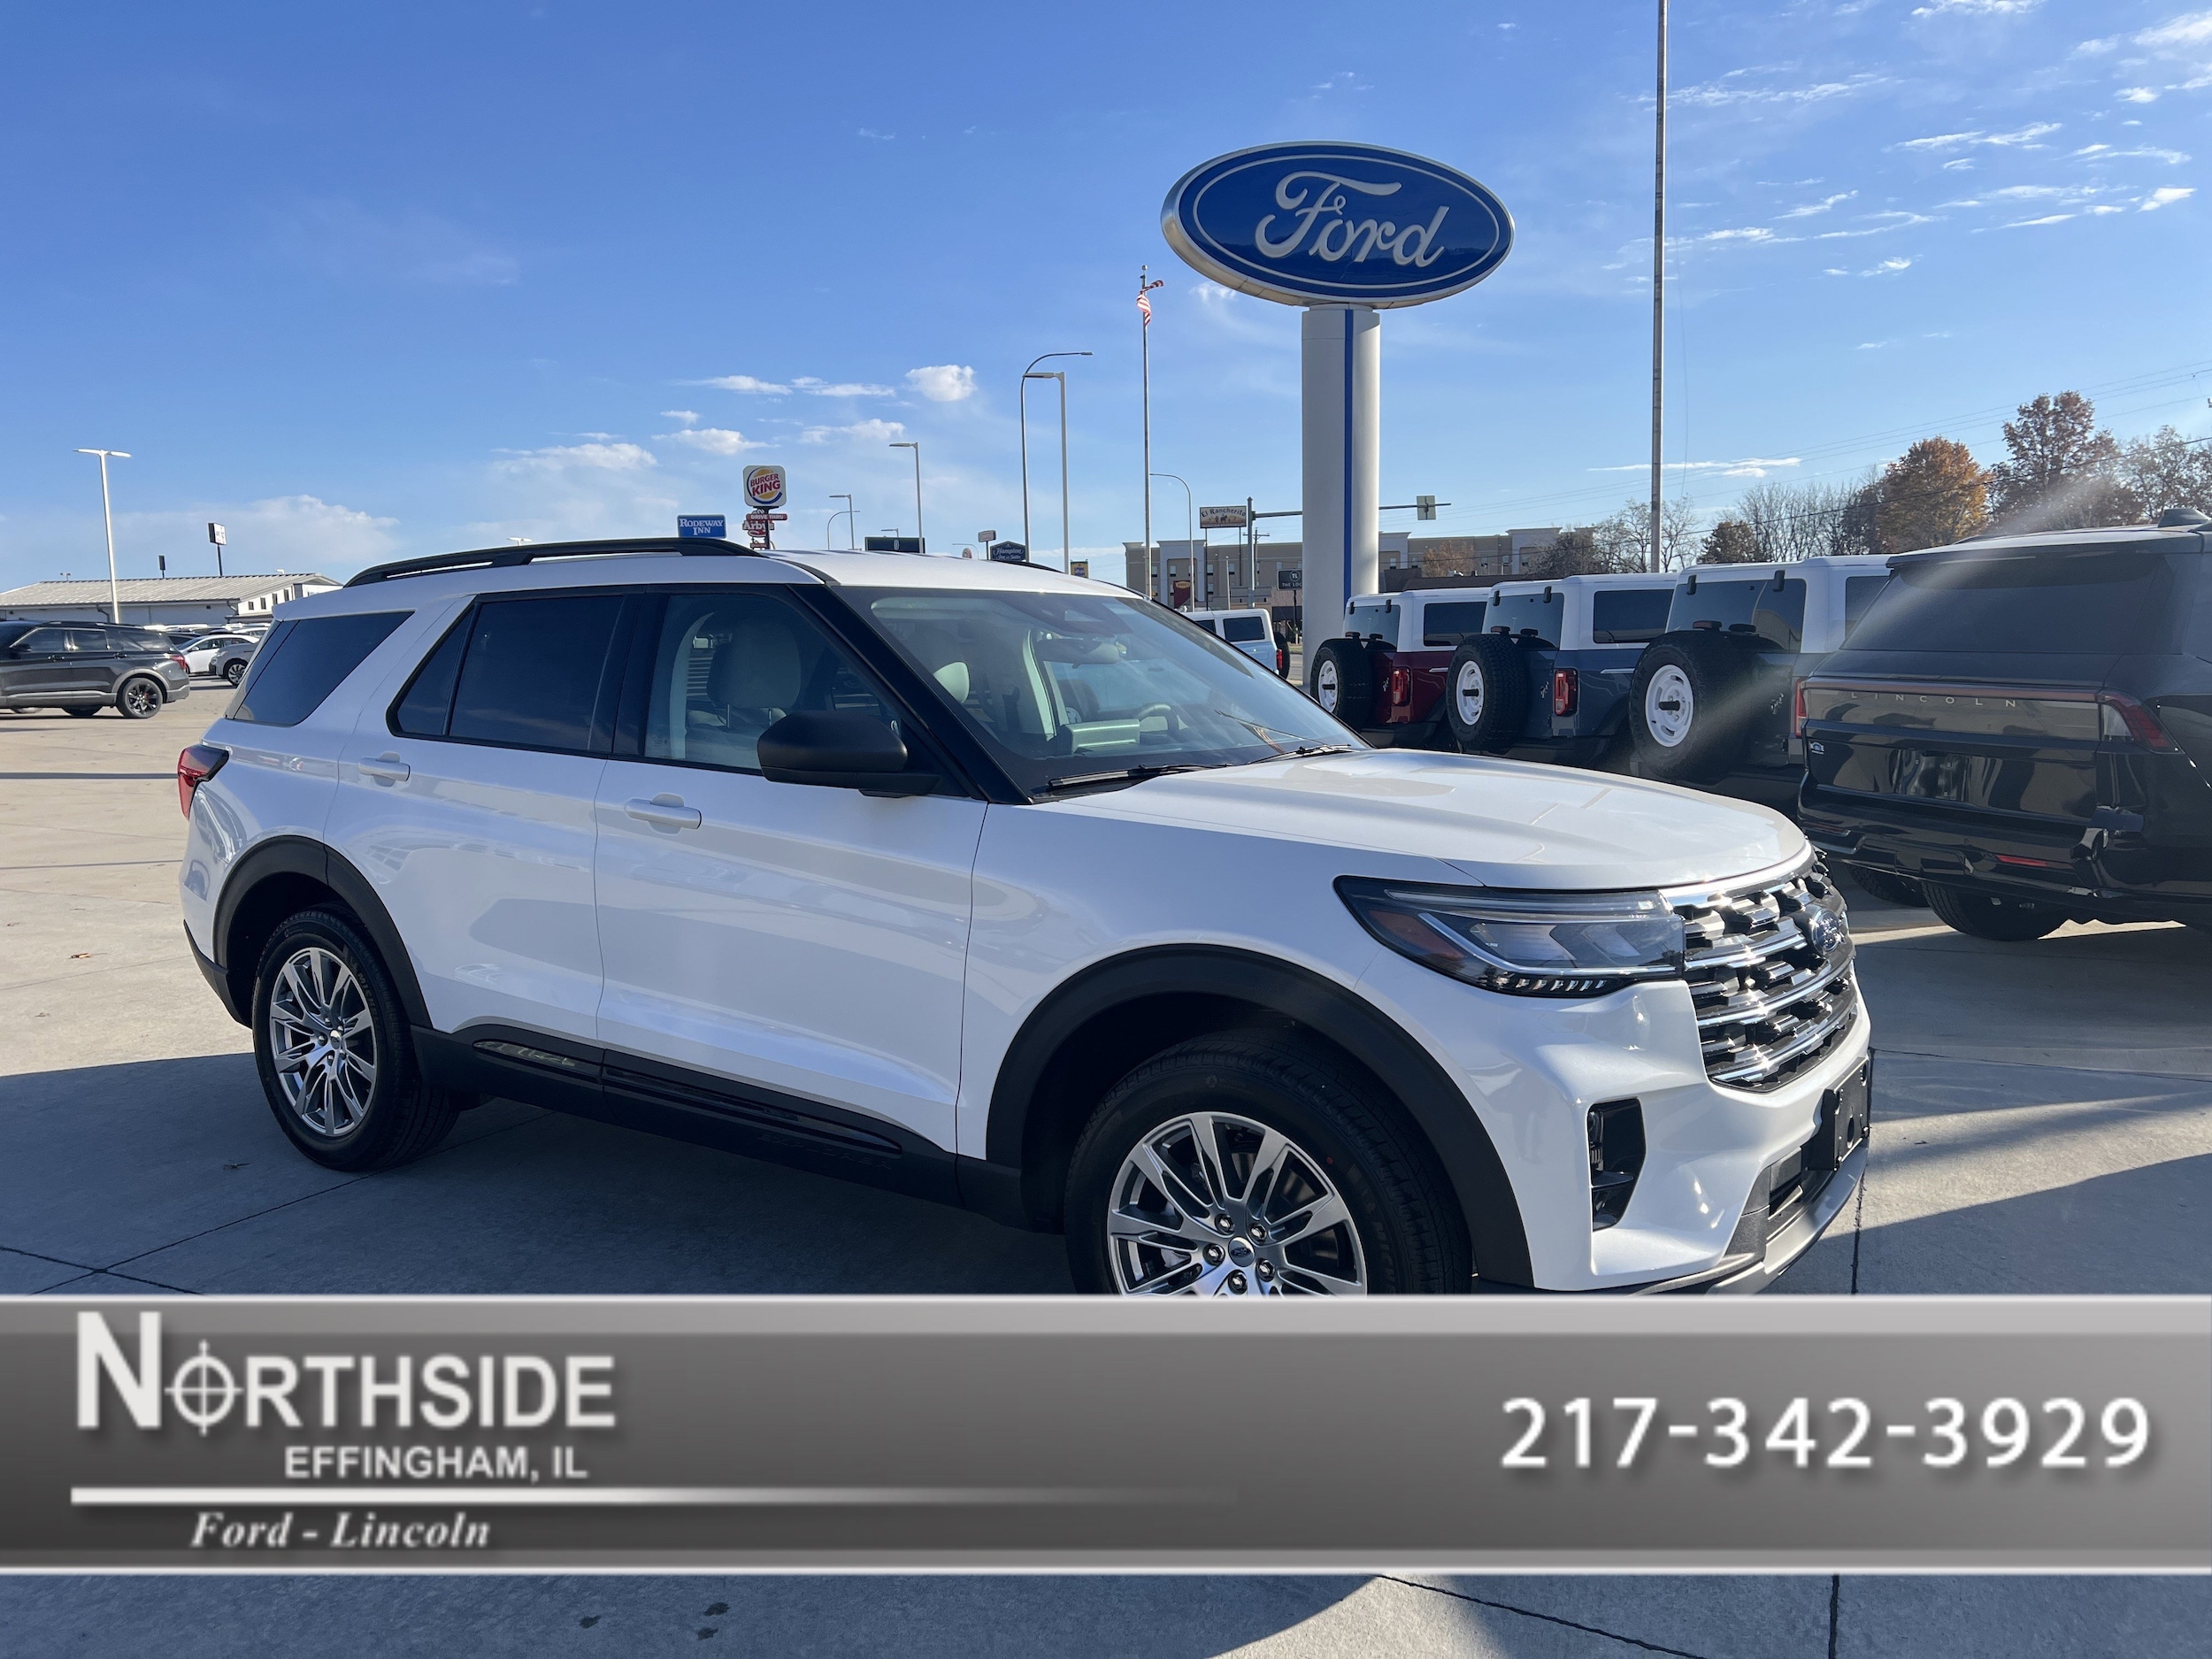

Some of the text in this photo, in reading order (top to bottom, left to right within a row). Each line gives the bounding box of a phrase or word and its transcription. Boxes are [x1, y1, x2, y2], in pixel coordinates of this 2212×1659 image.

[1255, 170, 1451, 268] Ford
[750, 473, 780, 488] BURGER
[752, 480, 781, 496] KING
[1210, 507, 1247, 517] Rancherito
[679, 518, 724, 527] RODEWAY
[693, 527, 711, 536] INN
[993, 548, 1025, 557] Hampton
[1851, 691, 2016, 708] LINCOLN
